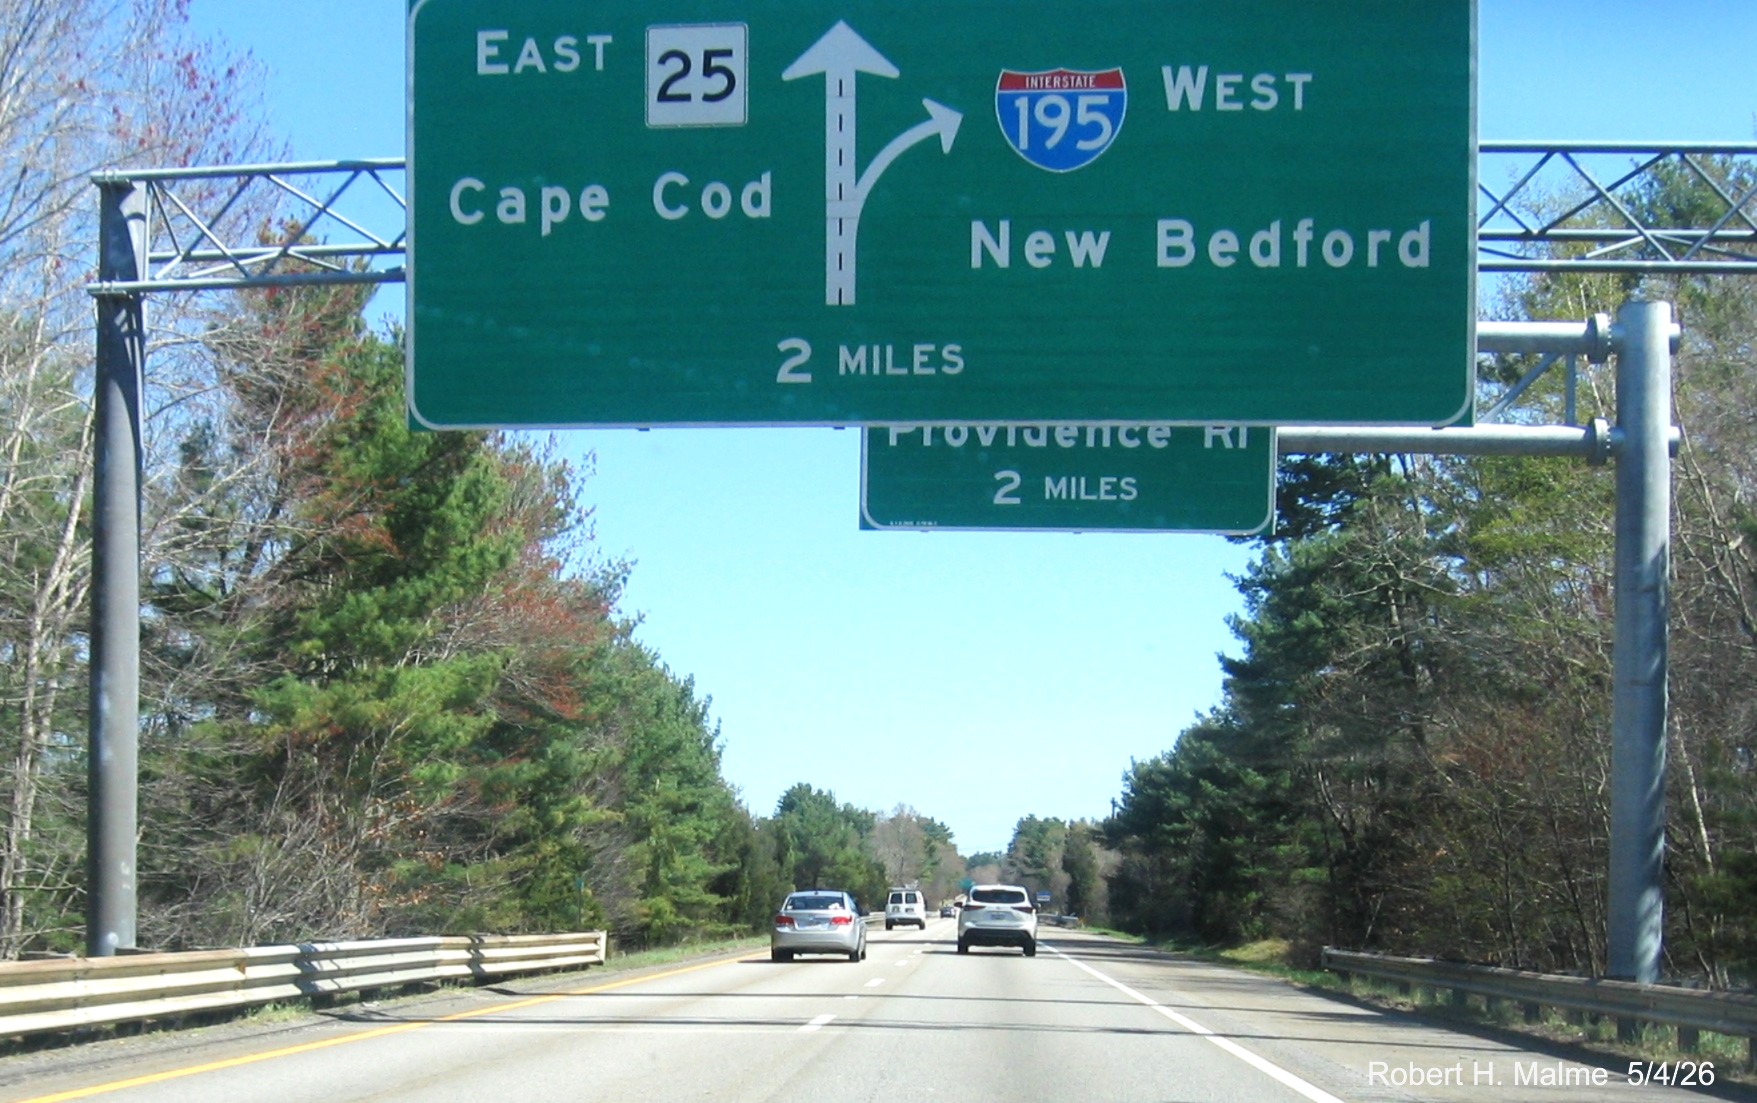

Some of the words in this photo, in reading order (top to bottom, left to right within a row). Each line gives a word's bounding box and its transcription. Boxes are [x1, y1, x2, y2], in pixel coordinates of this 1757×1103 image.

[476, 29, 614, 76] EAST
[656, 49, 737, 103] 25
[1024, 74, 1097, 90] INTERSTATE
[1161, 65, 1313, 112] WEST
[1014, 94, 1113, 151] 195
[449, 177, 610, 237] Cape
[652, 171, 772, 220] Cod
[970, 219, 1111, 269] New
[1156, 218, 1430, 269] Bedford
[776, 338, 812, 383] 2
[838, 344, 965, 376] MILES
[992, 470, 1022, 505] 2
[1044, 476, 1138, 501] MILES
